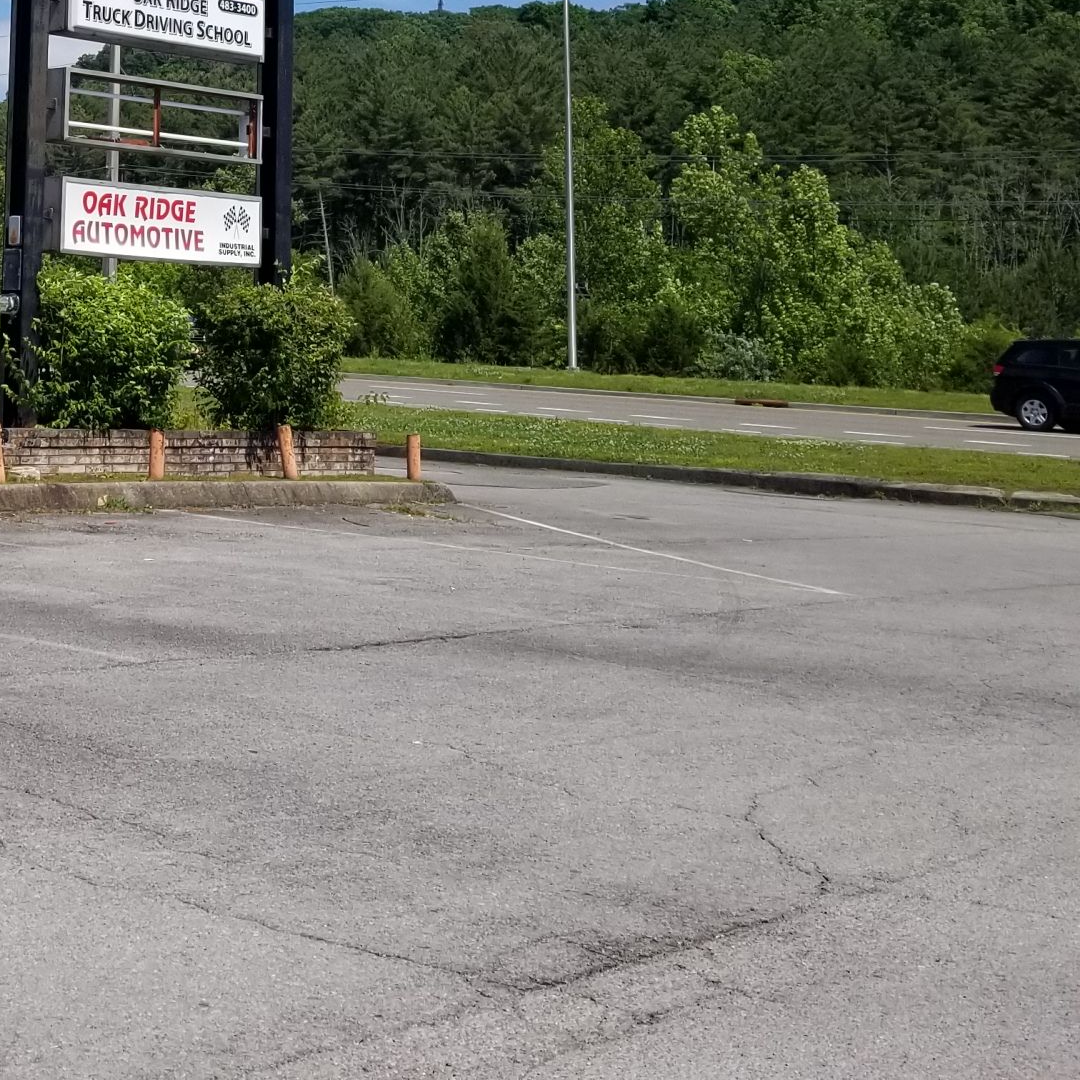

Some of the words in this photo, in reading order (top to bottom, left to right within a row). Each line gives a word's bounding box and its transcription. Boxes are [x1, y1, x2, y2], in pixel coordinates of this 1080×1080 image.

[219, 0, 258, 16] 483-3400
[83, 191, 127, 217] OAK
[134, 196, 196, 223] RIDGE
[72, 220, 205, 252] AUTOMOTIVE
[218, 248, 242, 258] SUPPLY,
[243, 250, 256, 258] INC.
[219, 242, 255, 251] INDUSTRIAL
